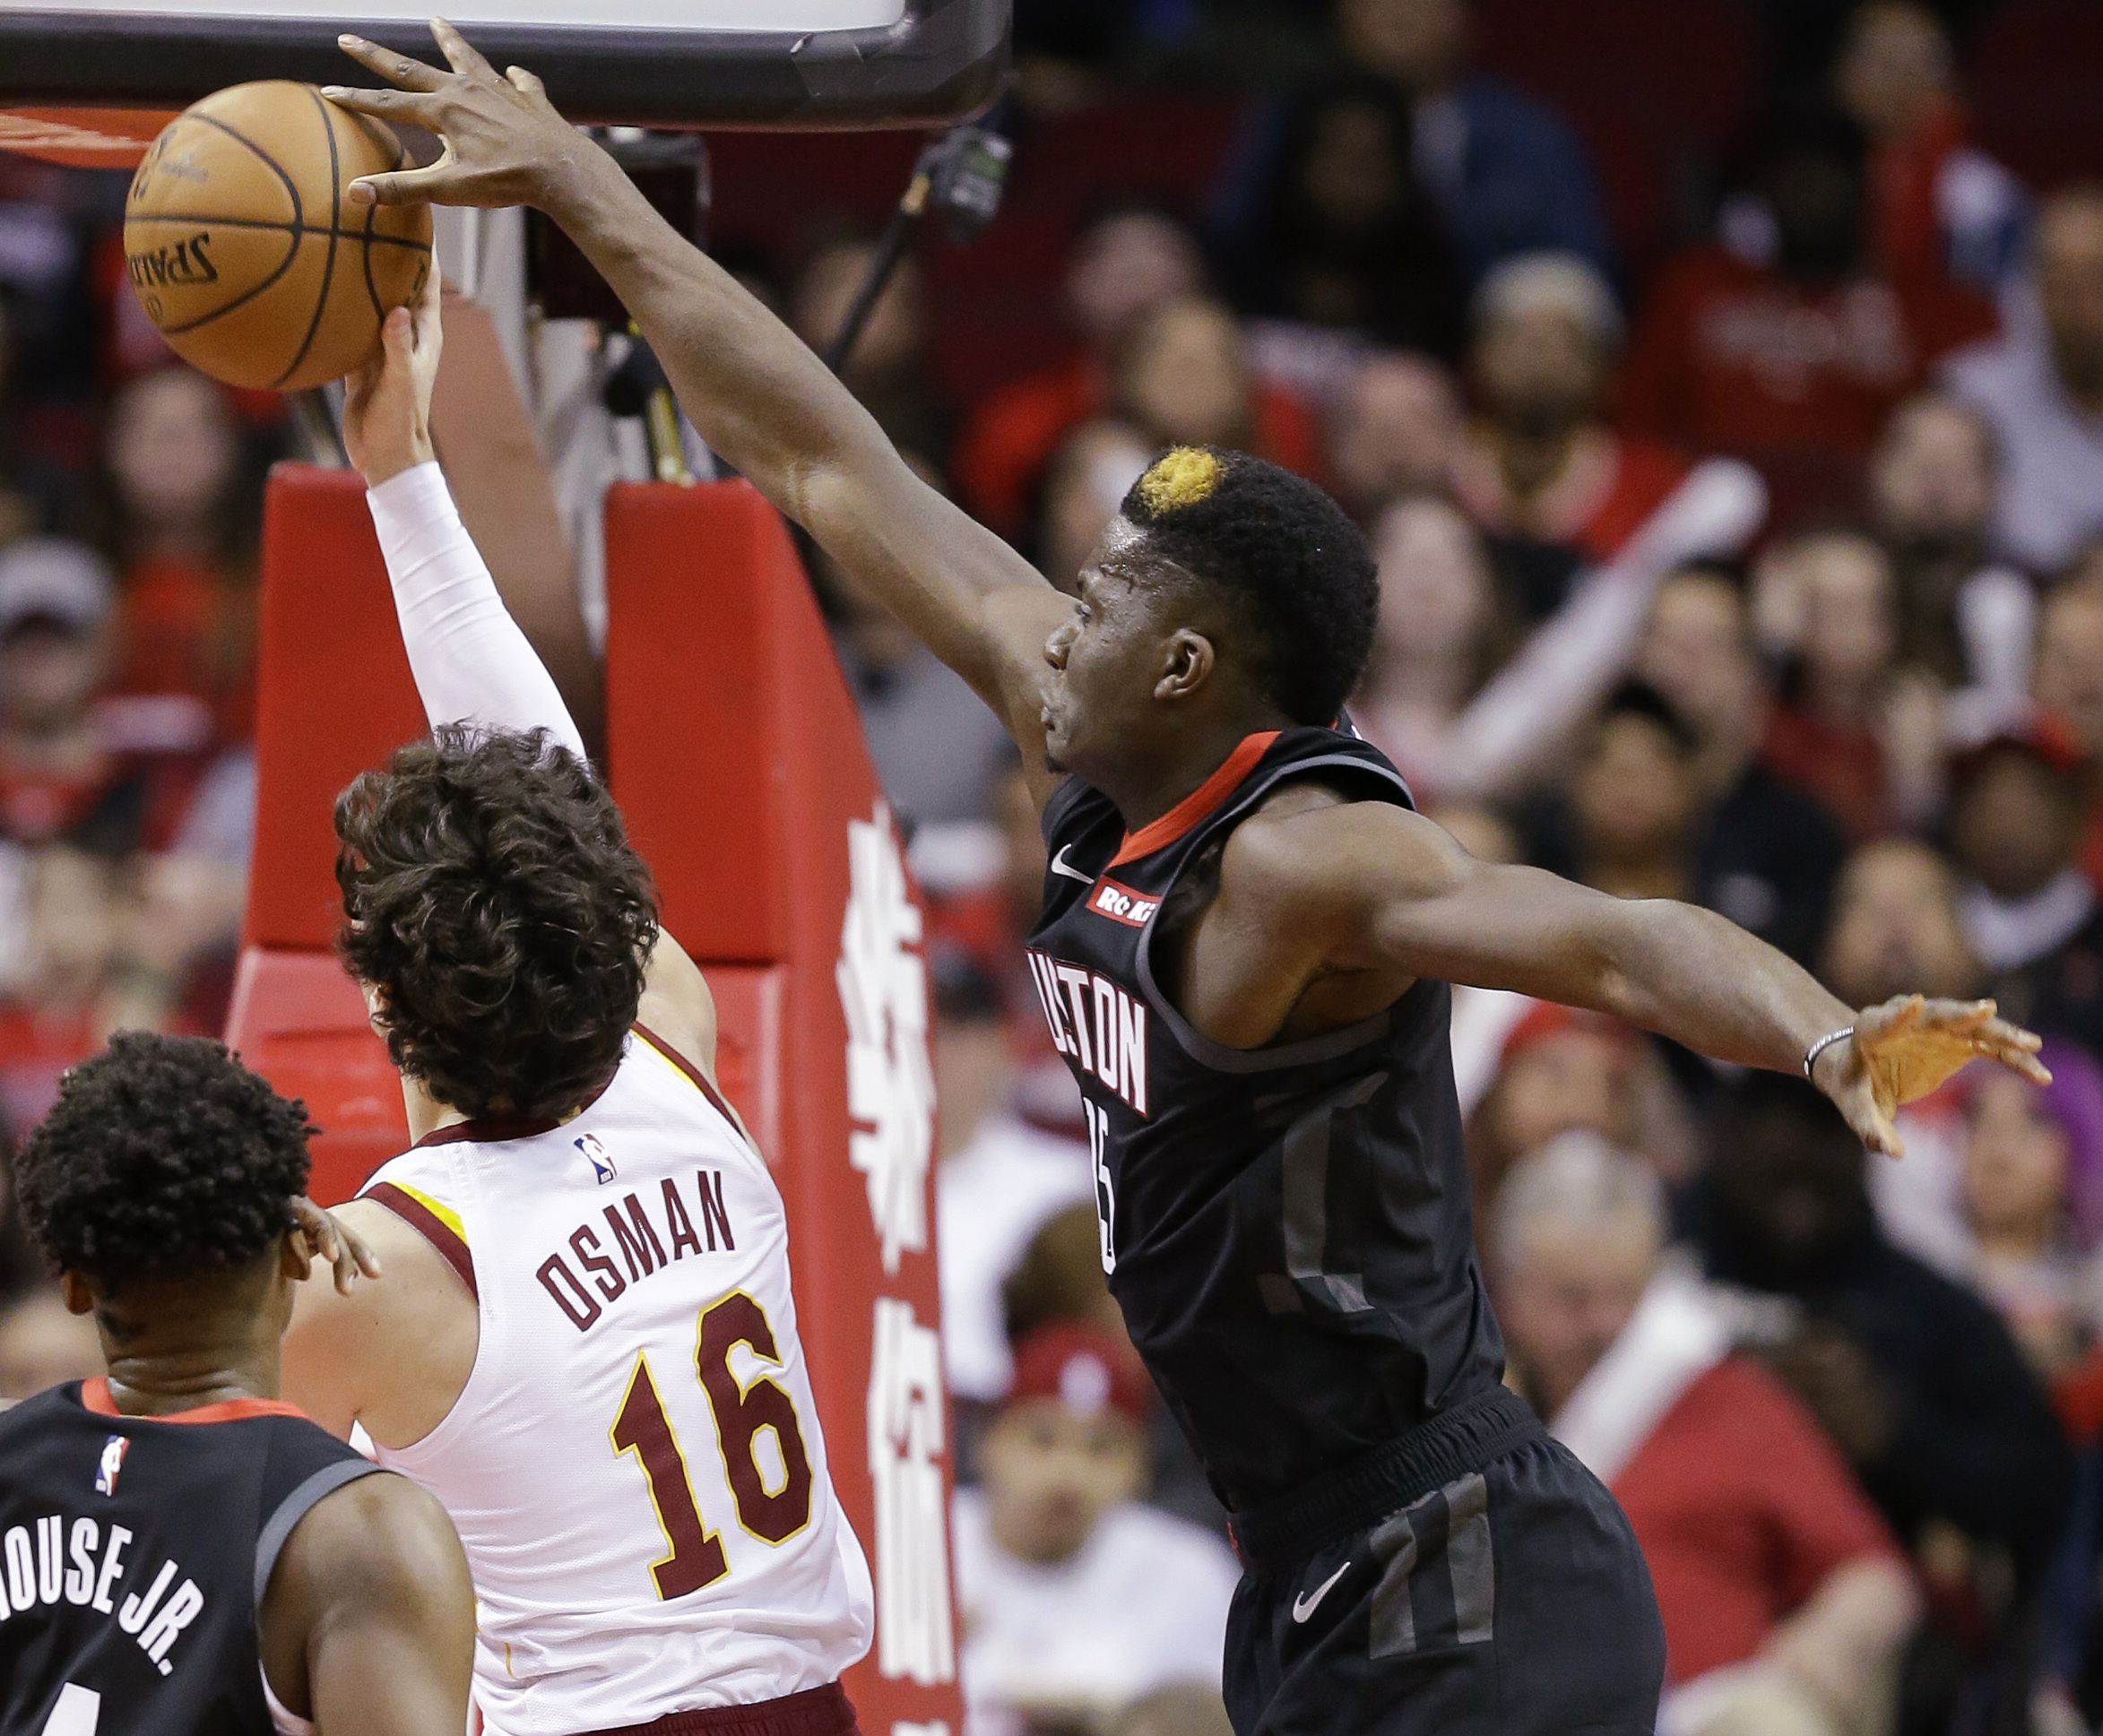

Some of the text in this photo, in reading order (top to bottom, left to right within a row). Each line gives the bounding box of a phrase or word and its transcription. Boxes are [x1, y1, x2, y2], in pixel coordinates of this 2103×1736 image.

[1095, 884, 1159, 923] ROKi
[535, 1170, 735, 1332] OSMAN
[609, 1287, 813, 1602] 16
[0, 1514, 205, 1677] OUSE JR.
